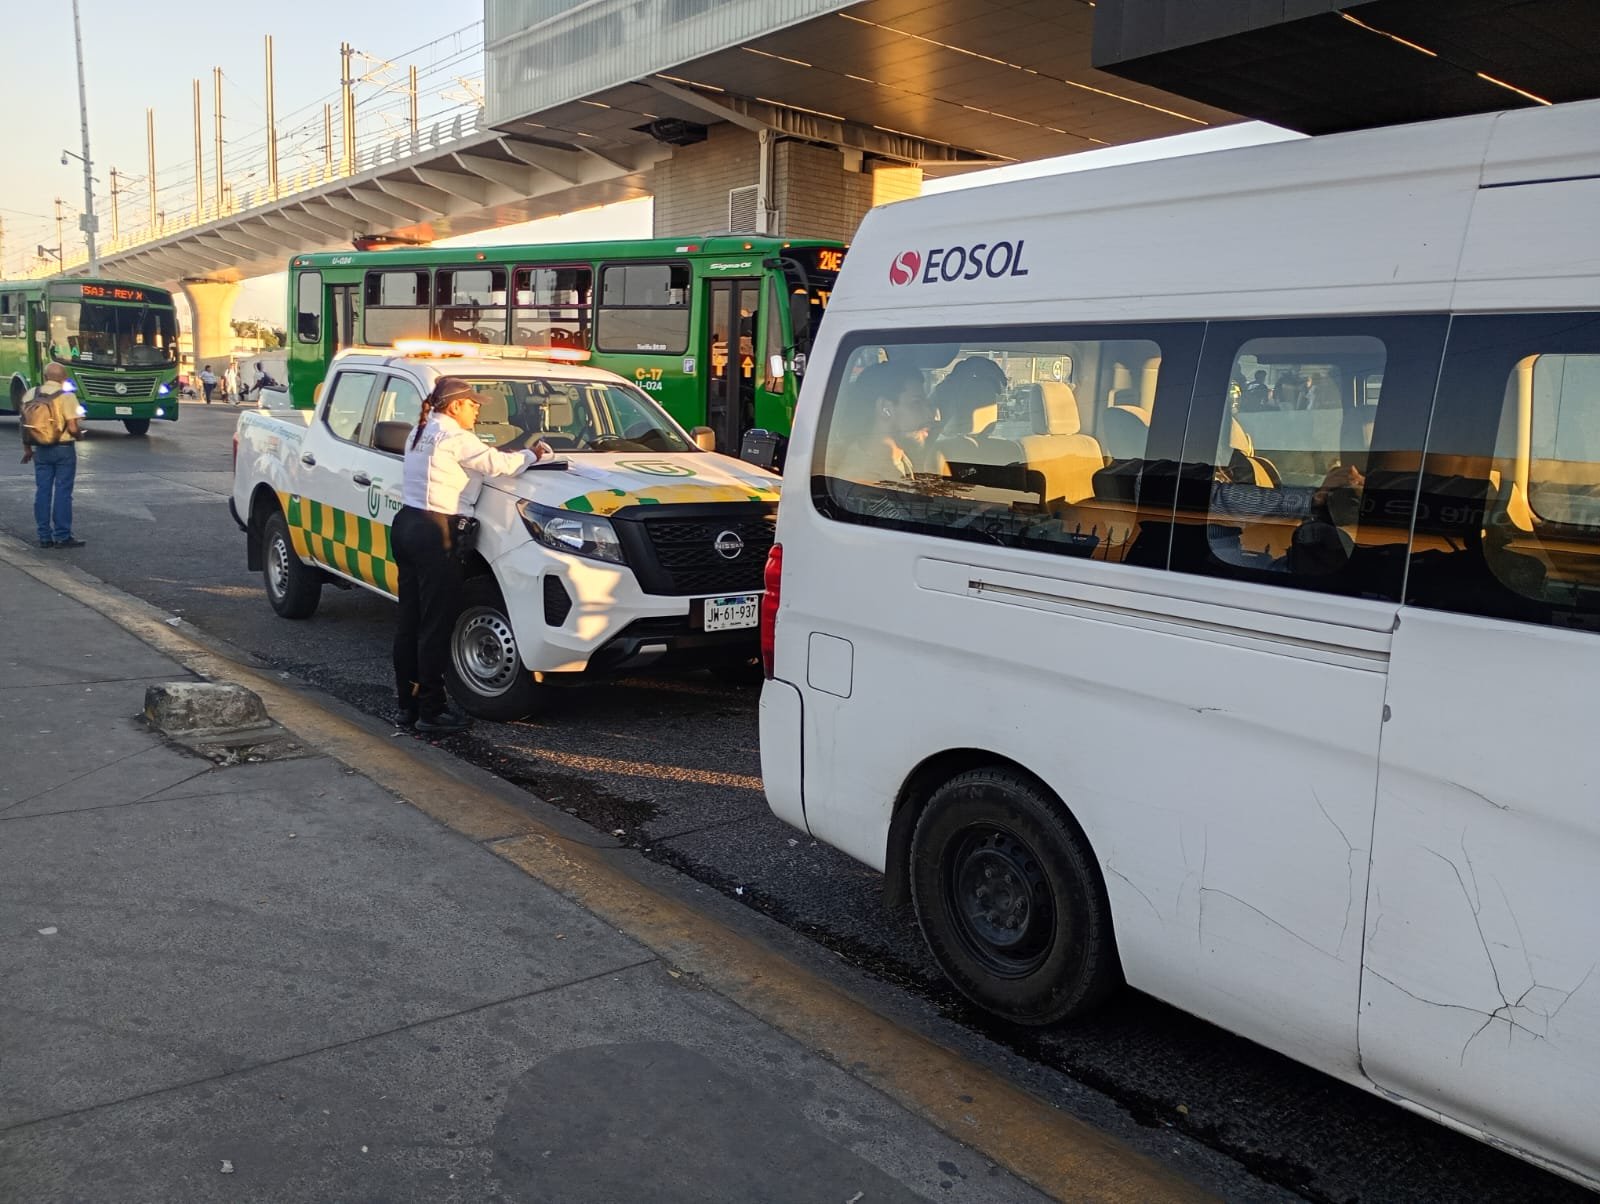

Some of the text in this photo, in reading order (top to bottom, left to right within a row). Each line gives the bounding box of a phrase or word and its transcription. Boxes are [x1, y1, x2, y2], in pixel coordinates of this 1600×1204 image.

[922, 239, 1029, 284] EOSOL
[114, 288, 134, 300] REY
[635, 367, 663, 380] C-17
[384, 494, 404, 511] Tran
[714, 541, 744, 550] NISSAN
